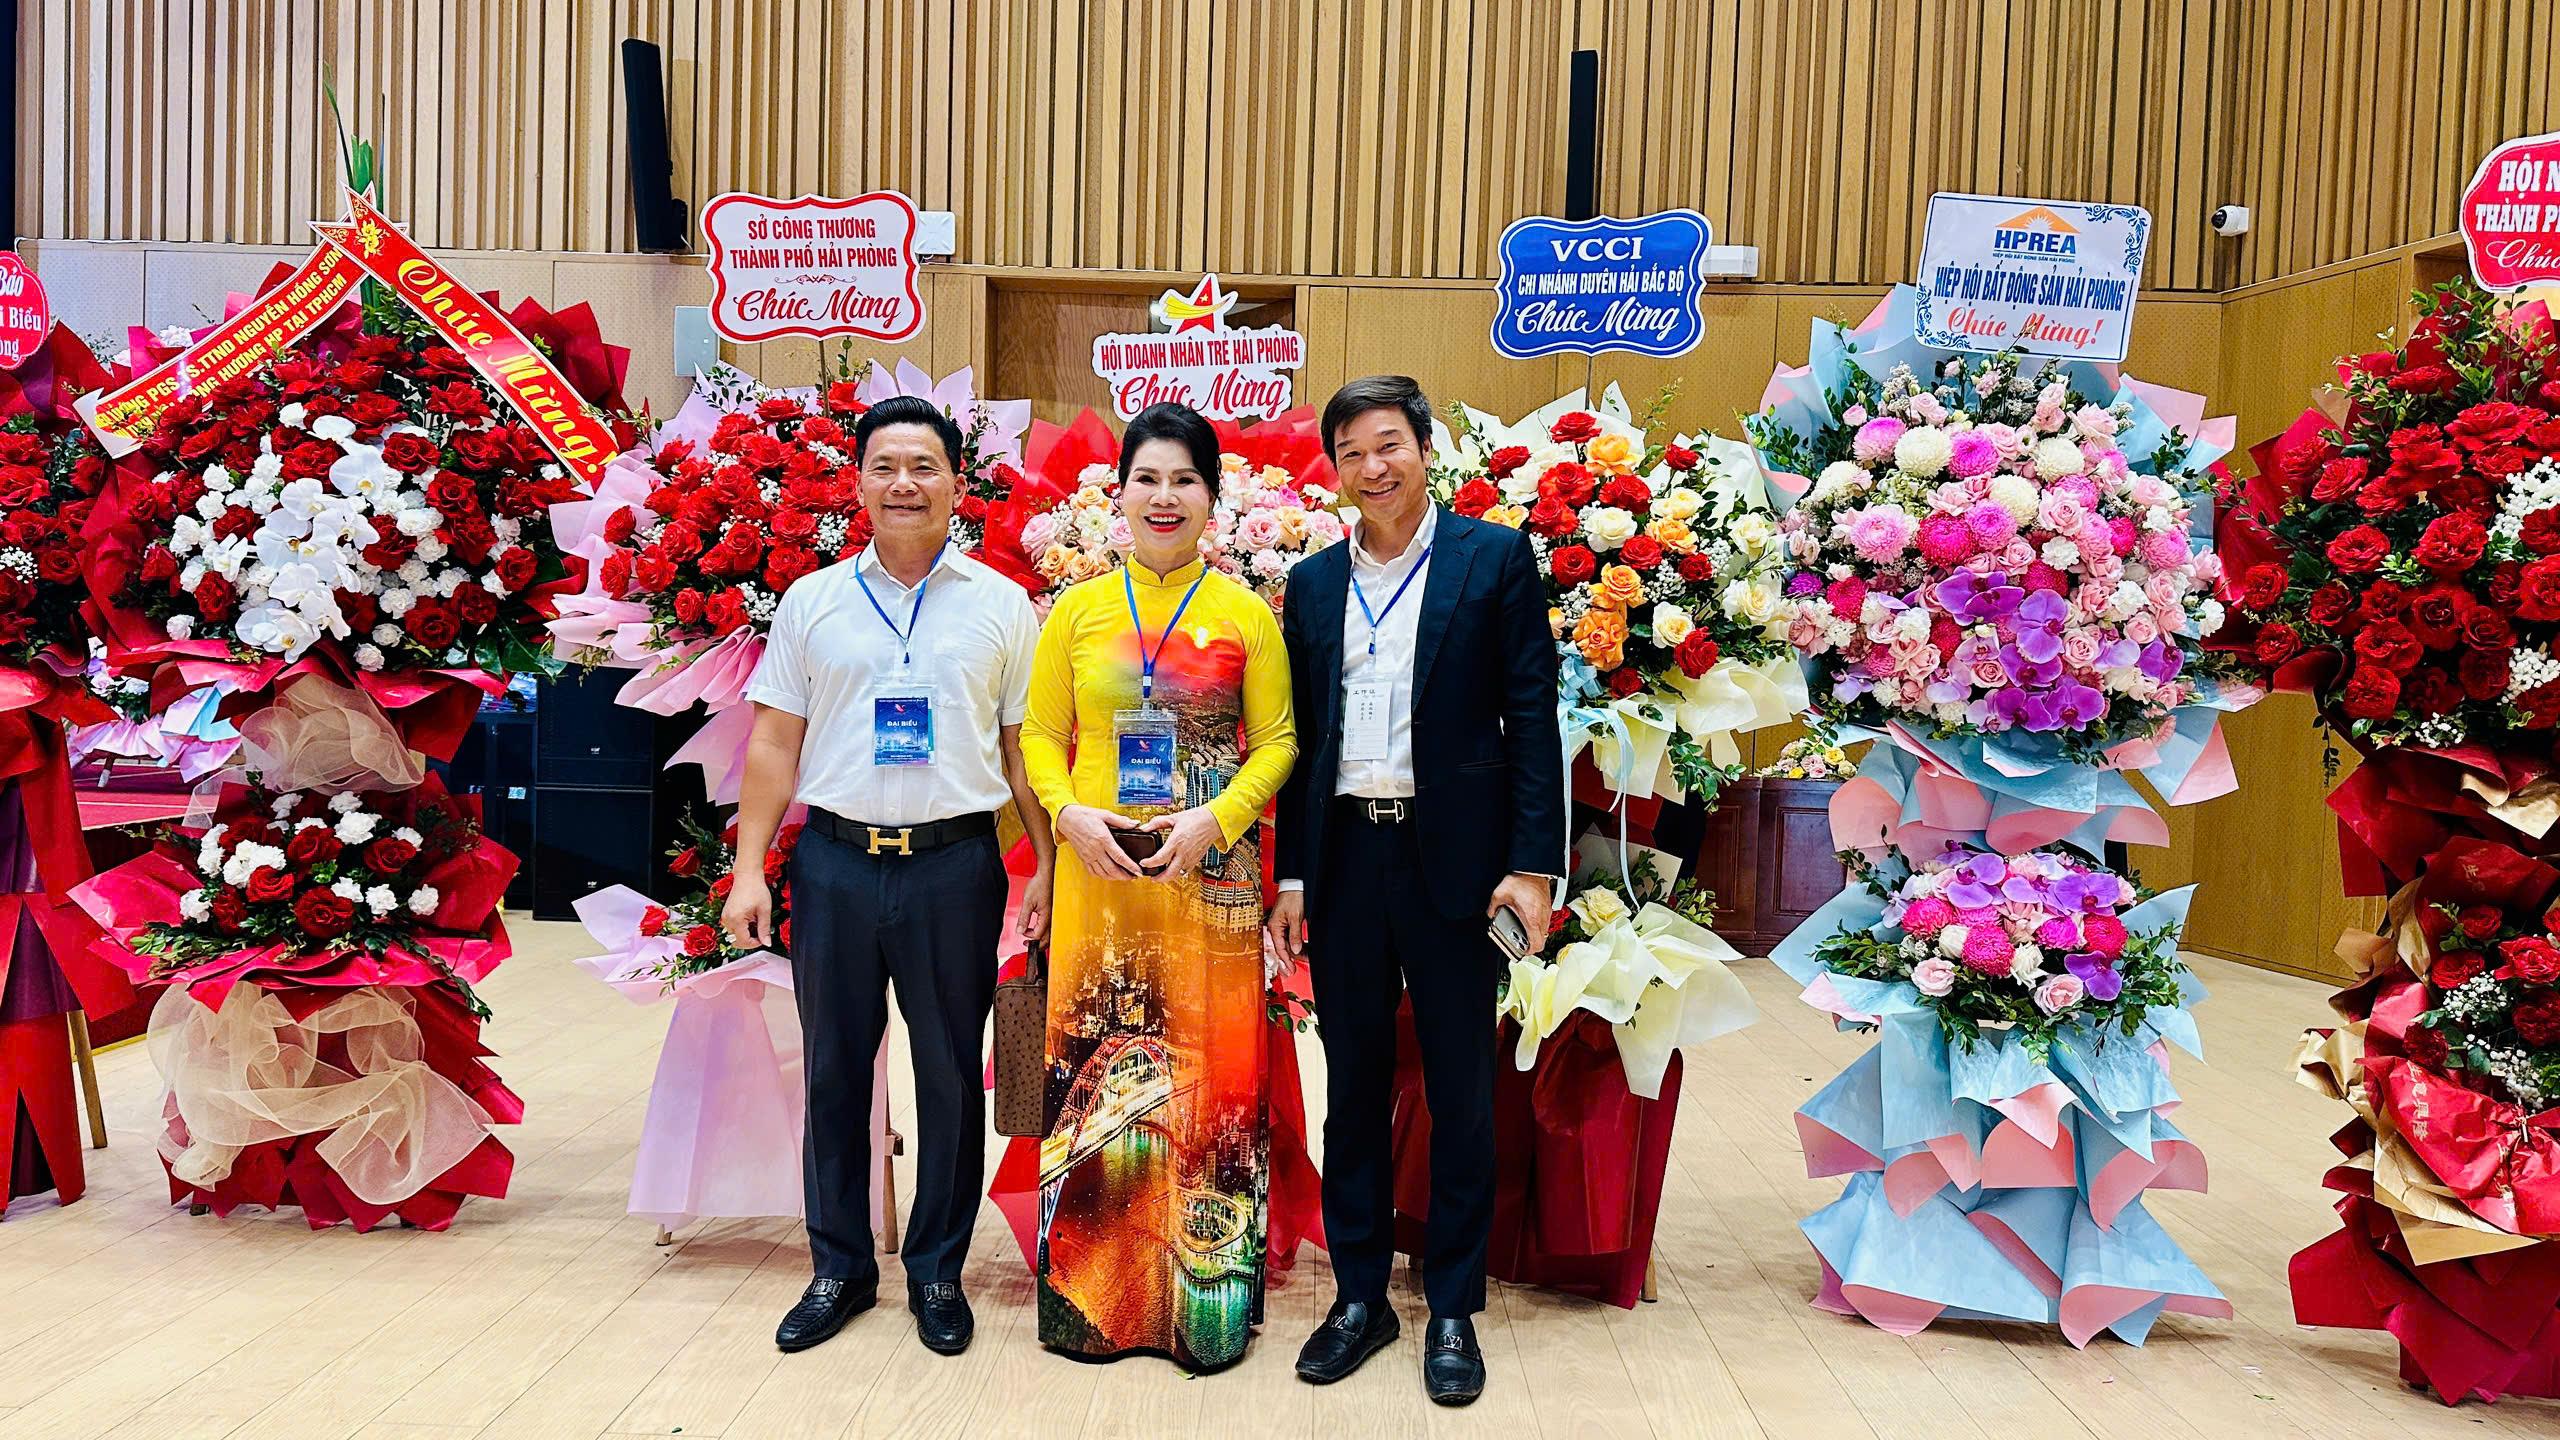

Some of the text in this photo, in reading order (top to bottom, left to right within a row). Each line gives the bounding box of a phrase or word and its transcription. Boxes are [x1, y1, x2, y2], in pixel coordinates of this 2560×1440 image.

[2498, 153, 2543, 199] HỘI
[748, 213, 876, 240] SỞ CÔNG THƯƠNG
[2475, 197, 2541, 233] THÀNH
[730, 241, 897, 269] THÀNH PHỐ HẢI PHÒNG
[1550, 236, 1644, 262] VCCI
[1994, 229, 2076, 254] HPREA
[232, 300, 290, 345] NGUYỄN
[286, 270, 323, 306] HỒNG
[318, 246, 344, 276] SƠN
[1518, 261, 1685, 297] CHI NHÁNH DUYÊN HẢI BẮC BỘ
[1934, 259, 2125, 312] HIỆP HỘI BẤT ĐỘNG SẢN HẢI PHÒNG
[8, 306, 42, 332] Biểu
[217, 342, 267, 382] HƯƠNG
[263, 327, 284, 347] HP
[283, 310, 309, 333] TẠI
[305, 272, 348, 316] TPHCM
[733, 286, 901, 329] Chúc Mừng
[1514, 296, 1680, 341] Chúc Mừng
[1947, 306, 2104, 350] Chúc Mừng!
[397, 258, 618, 474] Chúc Mừng!
[1101, 328, 1299, 376] HỘI DOANH NHÂN TRẺ HẢI PHÒNG
[1115, 367, 1285, 419] Chúc Mừng
